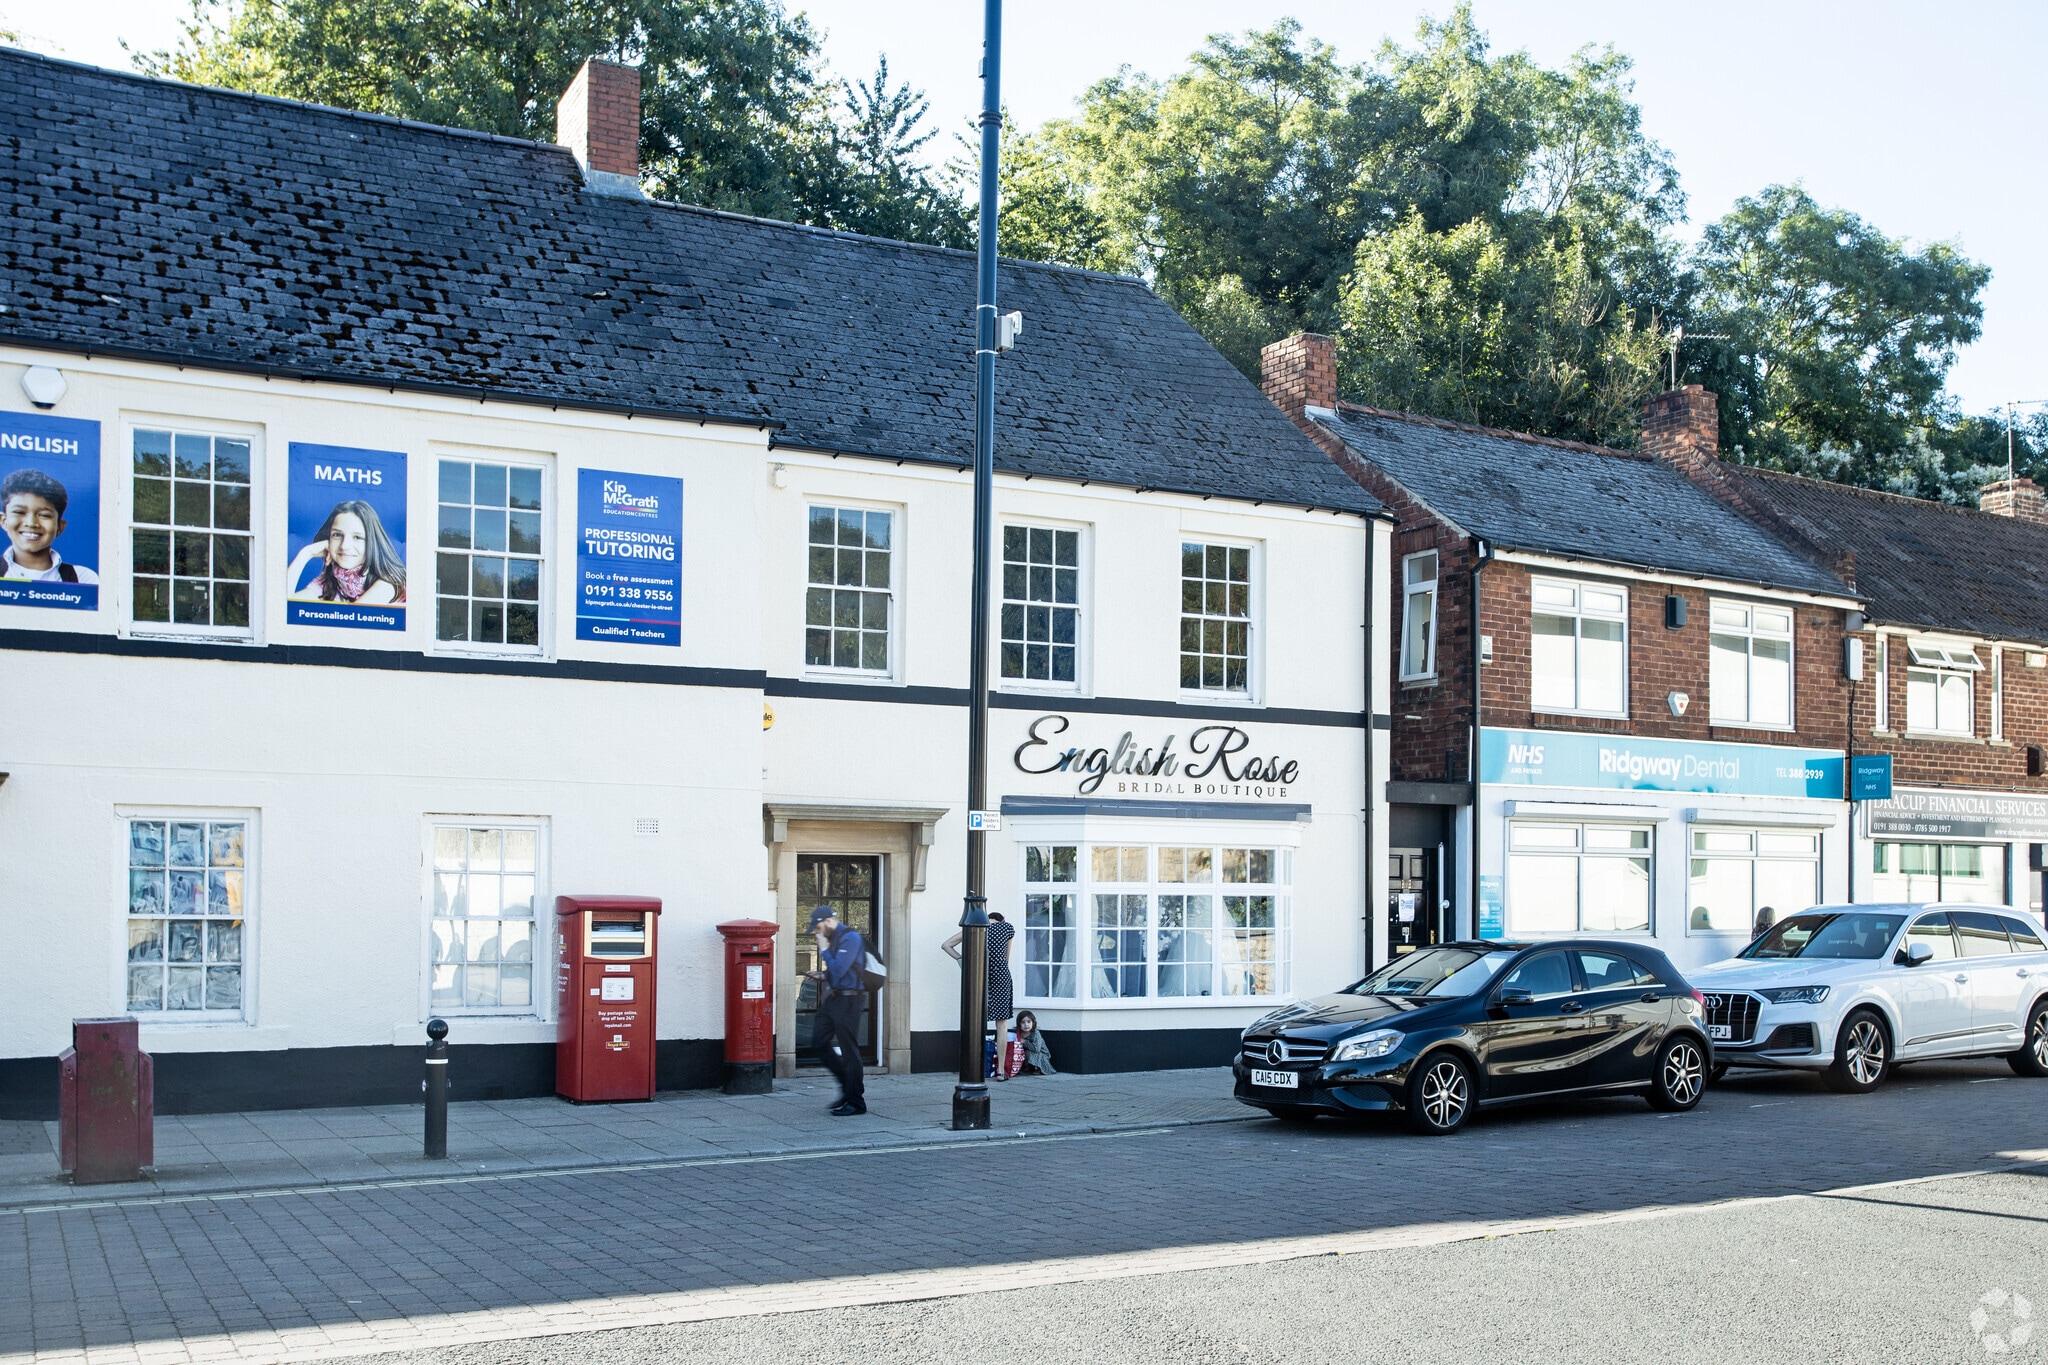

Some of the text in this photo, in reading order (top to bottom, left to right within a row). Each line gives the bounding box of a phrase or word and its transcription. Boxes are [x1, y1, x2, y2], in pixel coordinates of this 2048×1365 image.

[314, 464, 383, 486] MATHS
[603, 480, 627, 497] Kip
[603, 492, 658, 508] McGrath
[585, 528, 675, 545] PROFESSIONAL
[585, 540, 675, 561] TUTORING
[585, 571, 605, 580] Book
[612, 573, 629, 582] free
[630, 576, 674, 586] assessment
[28, 590, 82, 604] Secondary
[585, 584, 674, 602] 0191 338 9556
[298, 609, 395, 625] Personalised Learning
[592, 626, 666, 639] Qualified Teachers
[1014, 714, 1299, 795] English Rose
[1508, 744, 1545, 765] NHS
[1600, 749, 1740, 781] Ridgway Dental
[1858, 767, 1885, 776] Ridgway
[1775, 767, 1824, 780] TEL 388 2939
[1118, 782, 1288, 798] BRIDAL BOUTIQUE
[1873, 793, 2046, 817] DRACUP FINANCIAL SERVICES
[973, 814, 981, 827] P
[1873, 810, 1899, 818] FINANCIAL
[1899, 812, 1917, 820] ADVICE
[1921, 813, 1950, 822] INVESTMENT
[1961, 815, 1988, 823] RETIREMENT
[1989, 816, 2012, 824] PLANNING
[1873, 822, 1887, 831] 0191
[1888, 823, 1898, 831] 388
[1915, 824, 1928, 833] 0785
[1929, 825, 1938, 833] 500
[1939, 825, 1952, 833] 1917
[1710, 1026, 1727, 1037] FPJ
[1255, 1071, 1292, 1085] CA15 CDX
